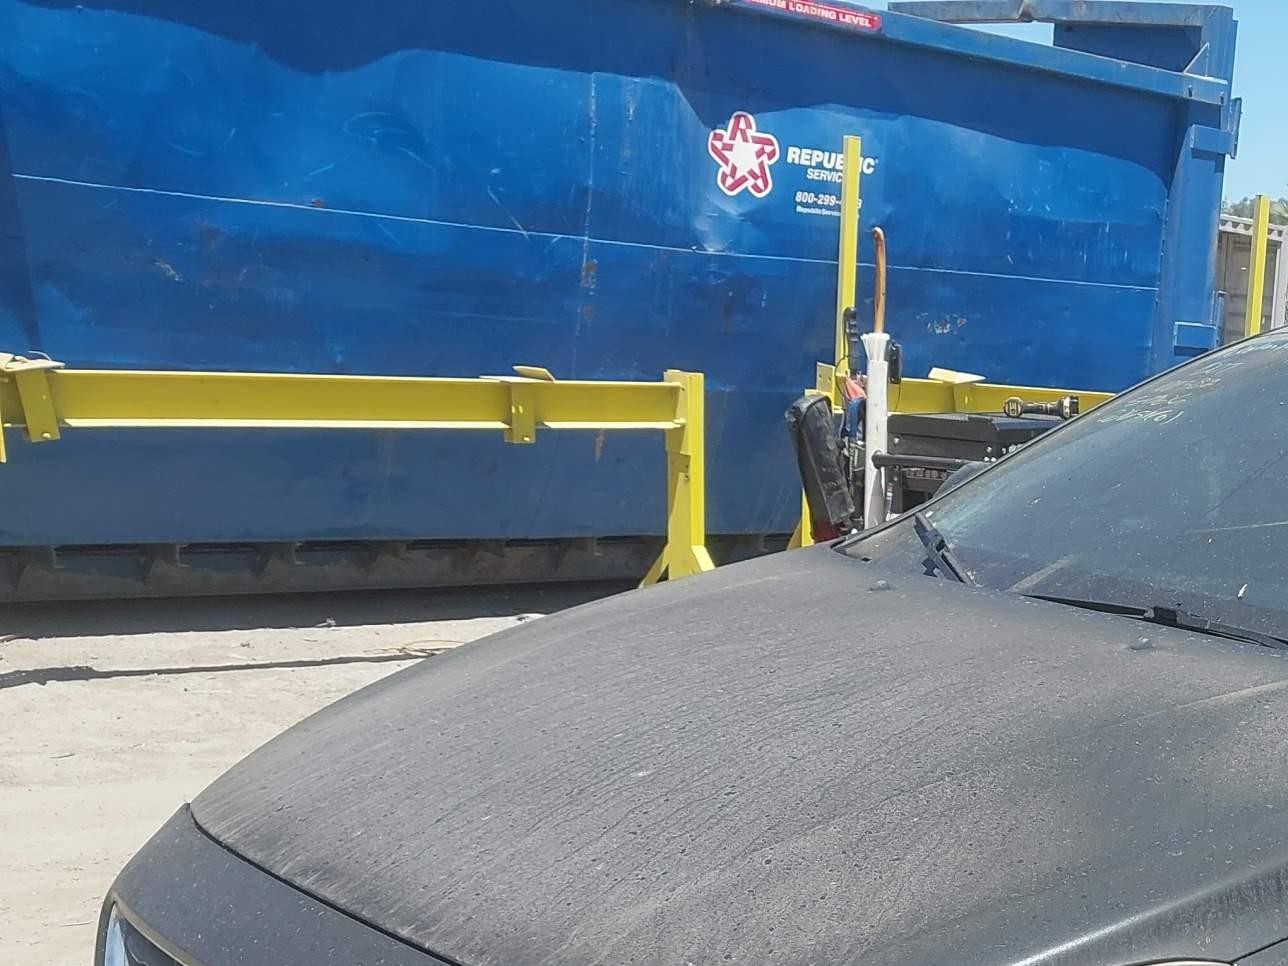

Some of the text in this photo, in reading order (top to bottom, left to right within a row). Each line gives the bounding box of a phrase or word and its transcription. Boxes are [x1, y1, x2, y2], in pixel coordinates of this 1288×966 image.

[789, 2, 837, 20] LOADING
[839, 11, 872, 27] LEVEL
[786, 146, 876, 175] REPUBIC
[806, 167, 843, 183] SERVIC
